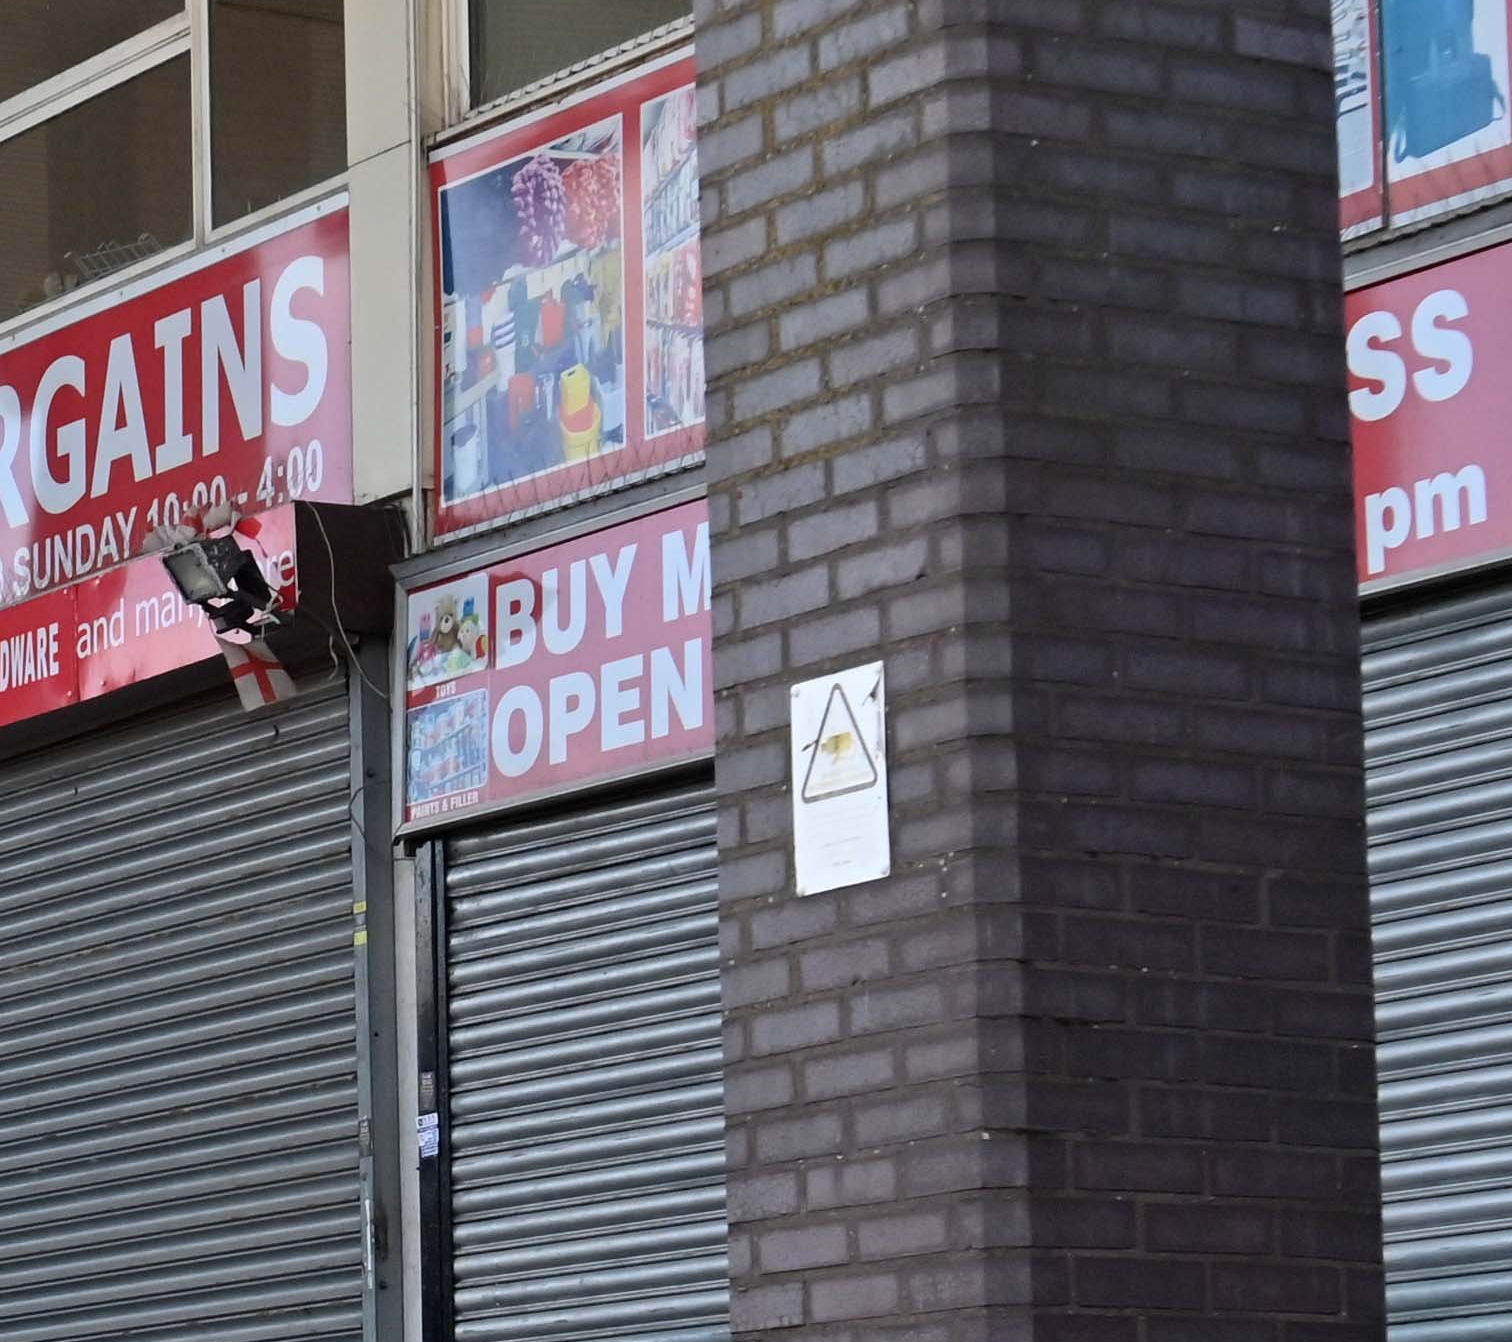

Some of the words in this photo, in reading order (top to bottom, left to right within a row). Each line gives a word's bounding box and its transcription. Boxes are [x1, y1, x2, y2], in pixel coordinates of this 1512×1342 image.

[13, 507, 138, 595] SUNDAY
[256, 439, 324, 507] 4:00
[1364, 463, 1489, 575] pm
[77, 602, 125, 658] and
[495, 543, 638, 670] BUY
[436, 681, 457, 700] TOYS
[491, 638, 703, 778] OPEN
[450, 791, 479, 811] FILLER
